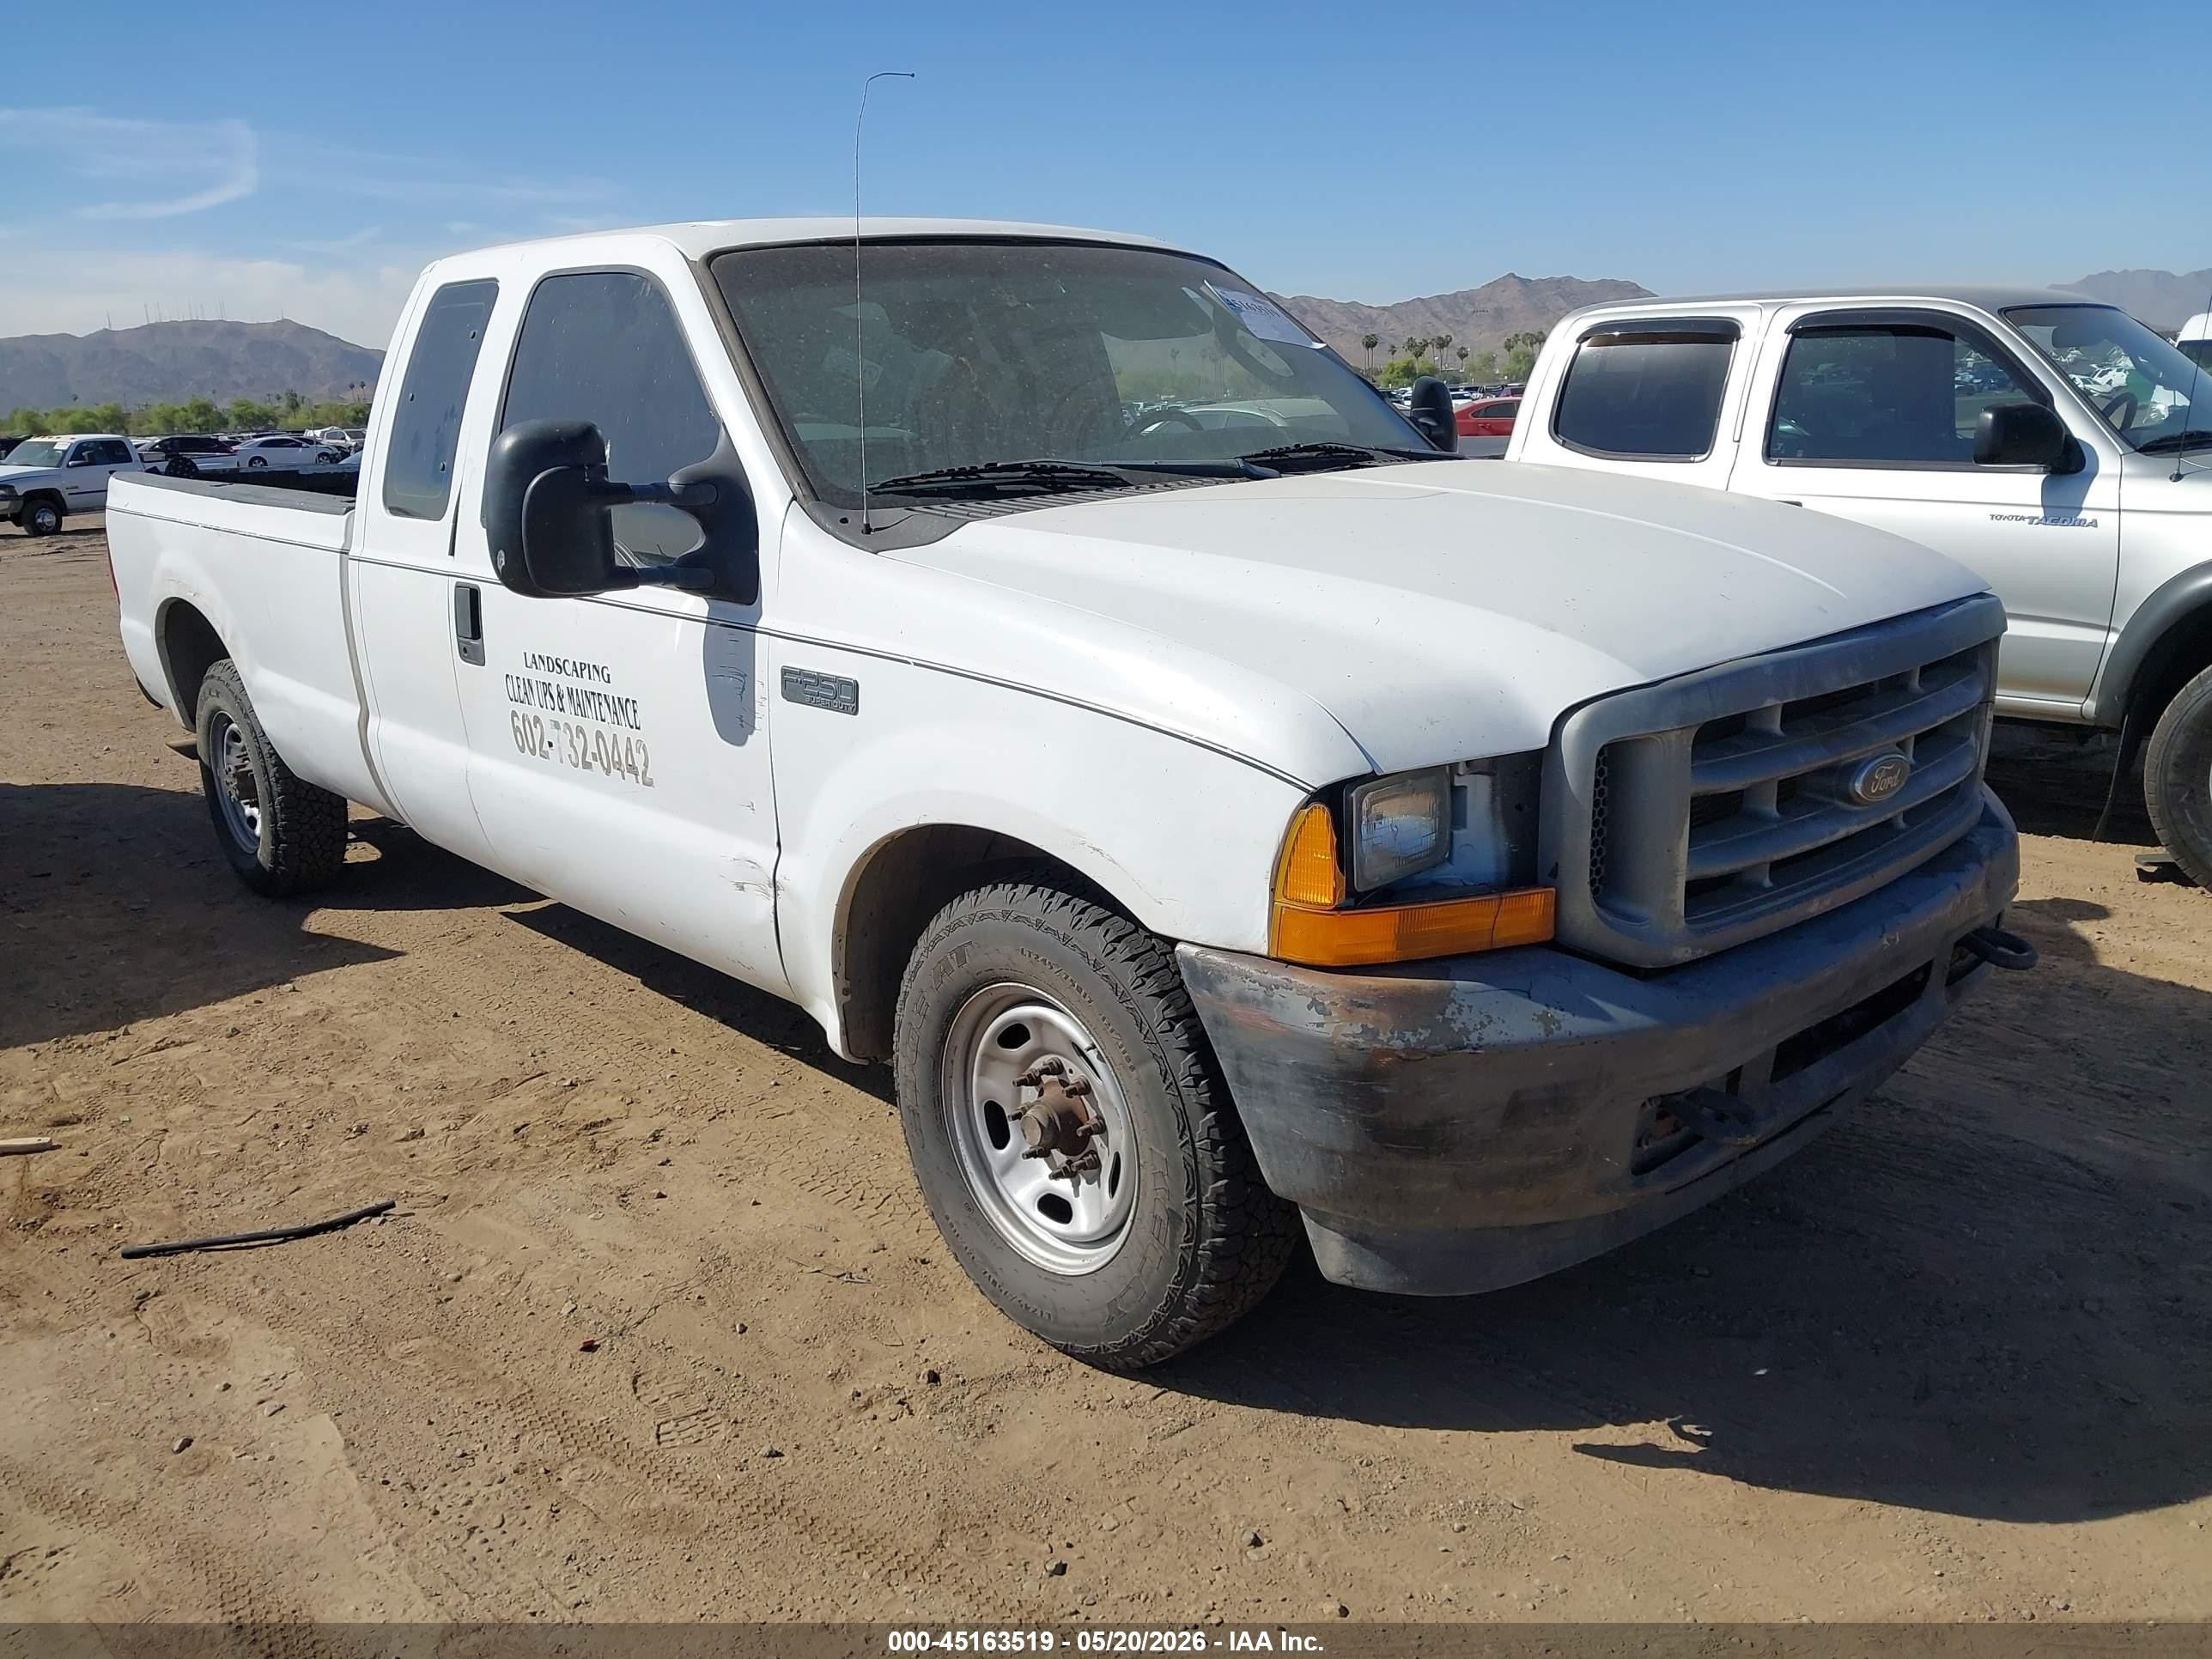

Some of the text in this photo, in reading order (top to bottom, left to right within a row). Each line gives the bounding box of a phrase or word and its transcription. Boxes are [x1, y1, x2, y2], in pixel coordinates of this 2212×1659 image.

[2025, 515, 2098, 527] TACOMA
[523, 652, 611, 684] LANDSCAPING
[505, 673, 641, 730] CLEAN UPS & MAINTENANCE
[782, 667, 856, 704] F-250
[805, 696, 855, 714] SUPER DUTY
[510, 709, 655, 787] 602-732-0442
[1871, 763, 1901, 793] Ford
